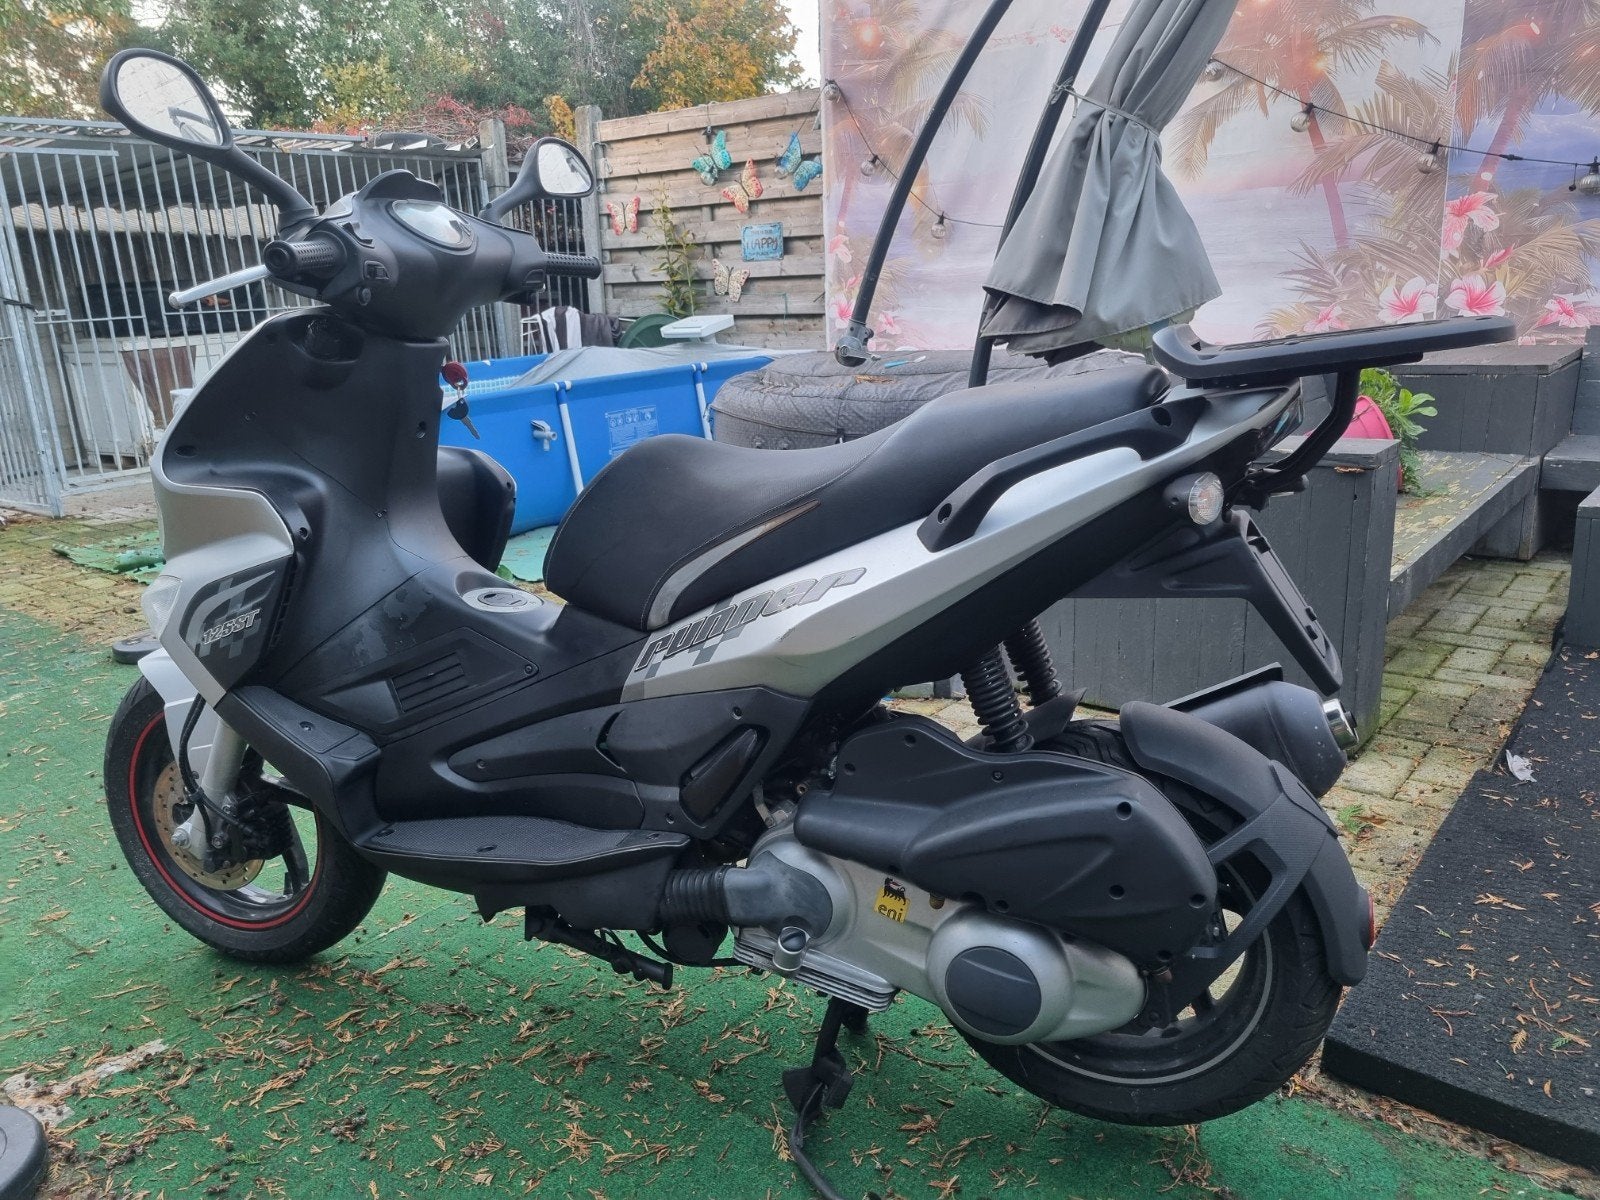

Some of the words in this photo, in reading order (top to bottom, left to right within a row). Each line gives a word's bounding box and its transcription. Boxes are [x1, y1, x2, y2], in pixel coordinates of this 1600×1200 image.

[203, 608, 261, 645] 125ST
[634, 567, 867, 672] runner
[877, 904, 904, 922] eni
